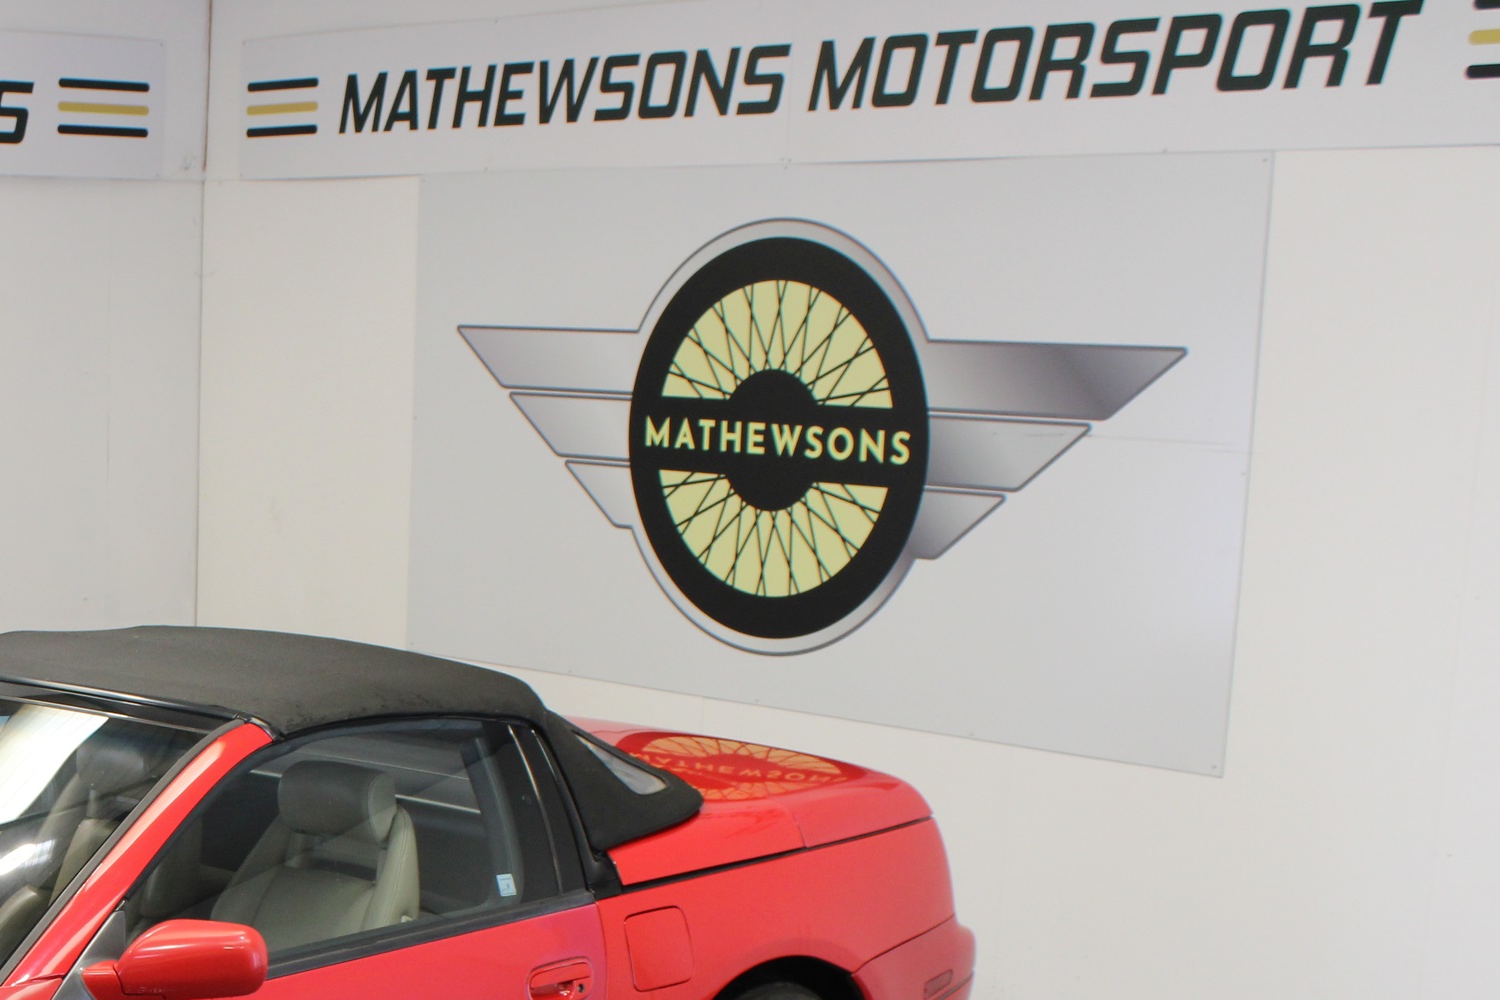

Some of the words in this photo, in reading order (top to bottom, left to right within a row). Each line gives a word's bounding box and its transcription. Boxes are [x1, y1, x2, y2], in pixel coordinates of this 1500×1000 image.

[338, 43, 792, 134] MATHEWSONS
[807, 0, 1424, 111] MOTORSPORT
[645, 415, 911, 465] MATHEWSONS
